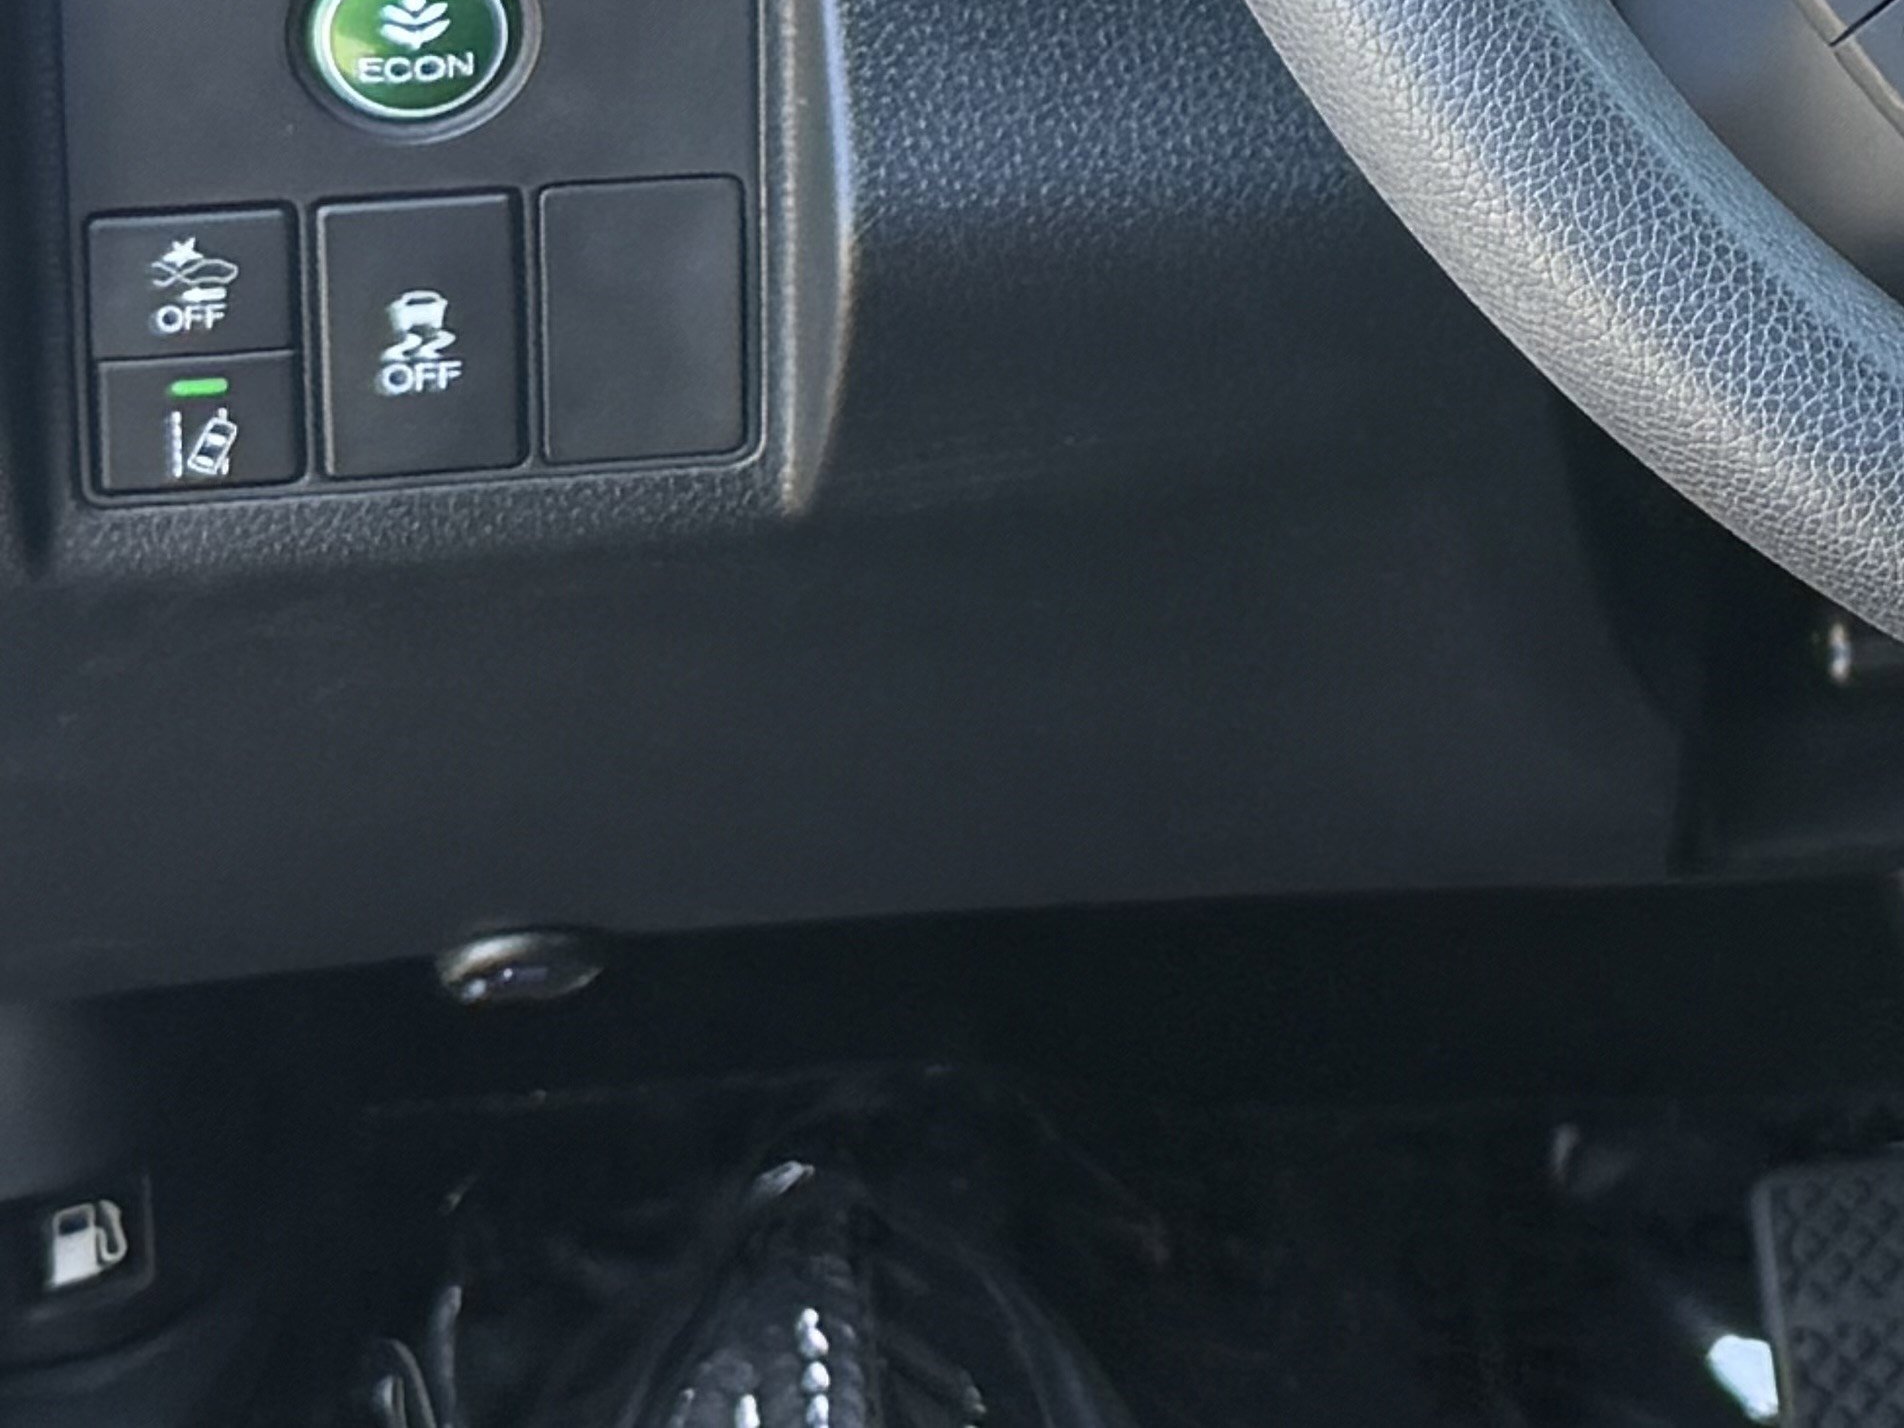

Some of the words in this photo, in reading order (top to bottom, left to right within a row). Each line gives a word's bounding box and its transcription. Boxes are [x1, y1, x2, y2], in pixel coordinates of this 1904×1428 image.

[356, 51, 475, 86] ECON
[154, 303, 227, 336] OFF
[379, 359, 462, 395] OFF
